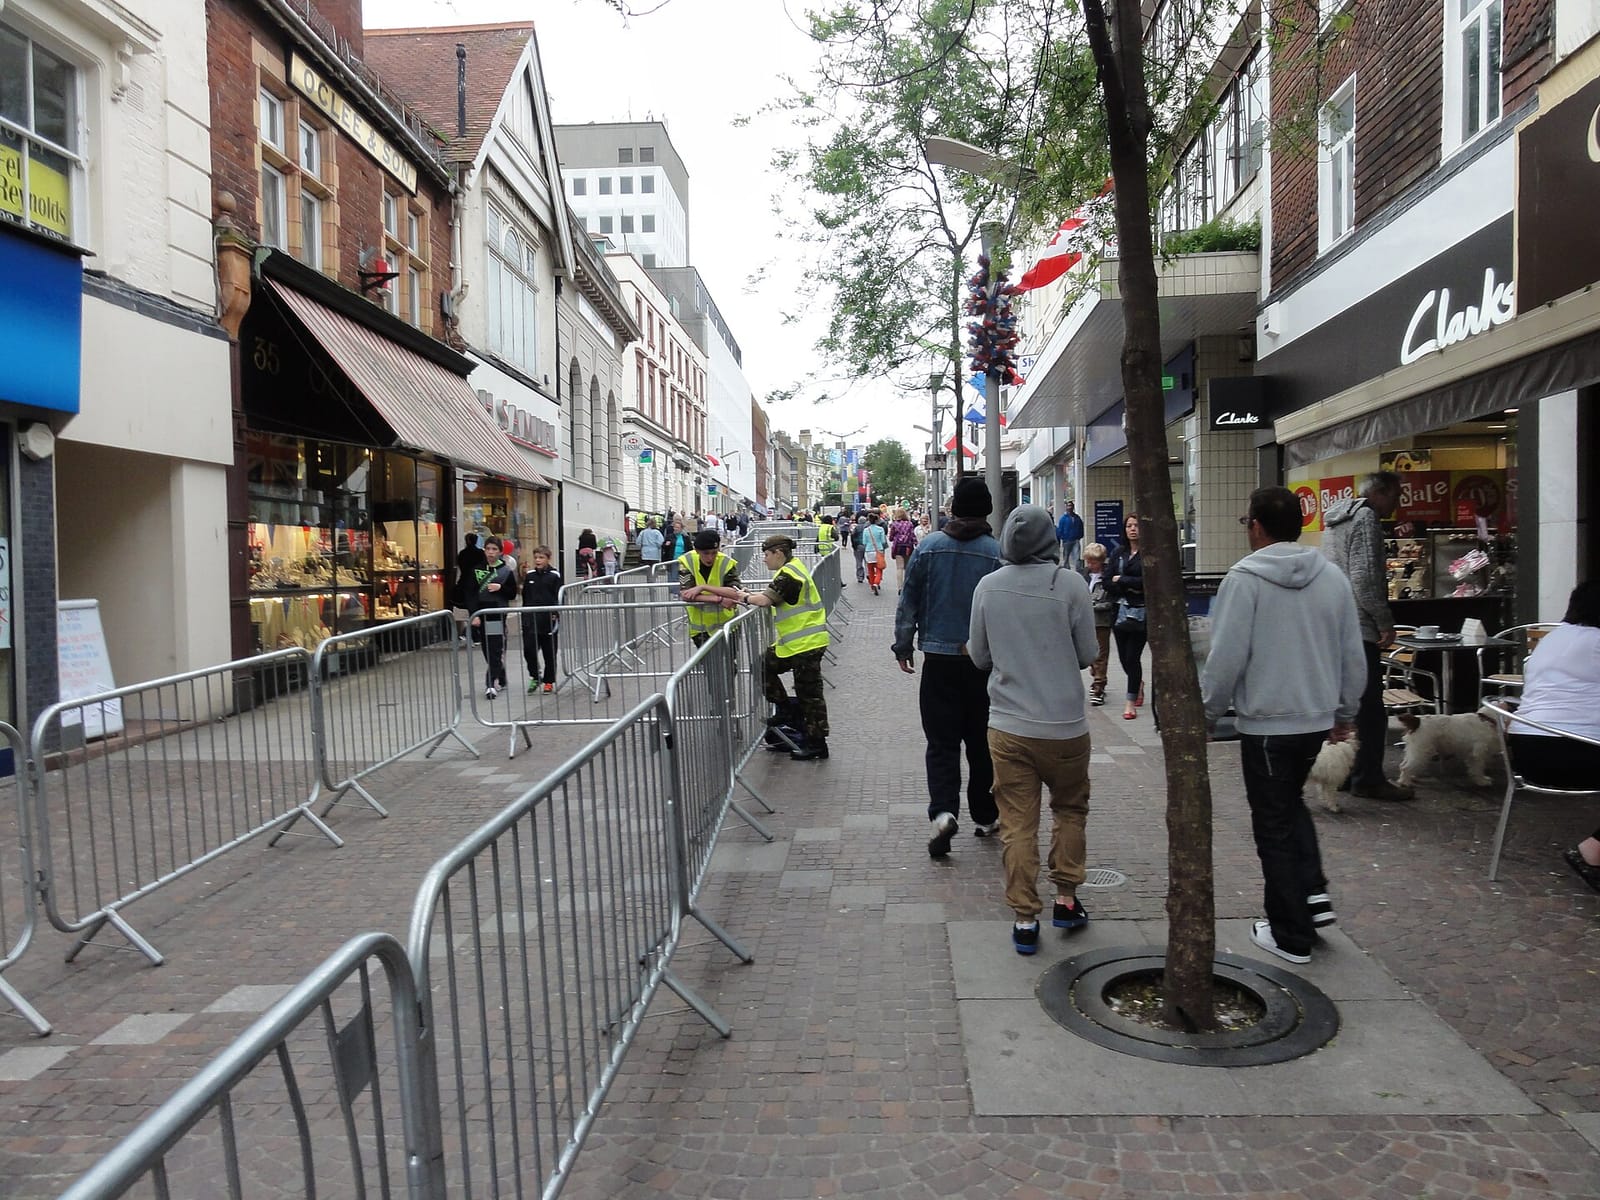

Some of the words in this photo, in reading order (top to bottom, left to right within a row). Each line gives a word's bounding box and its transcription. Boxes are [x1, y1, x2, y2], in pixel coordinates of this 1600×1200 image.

[303, 68, 363, 138] OCLEE
[366, 128, 376, 153] &
[1400, 267, 1515, 366] Clarks
[253, 336, 280, 376] 35
[496, 399, 558, 453] SAMUEL
[1215, 411, 1260, 425] Clarks
[624, 443, 643, 451] HSBC
